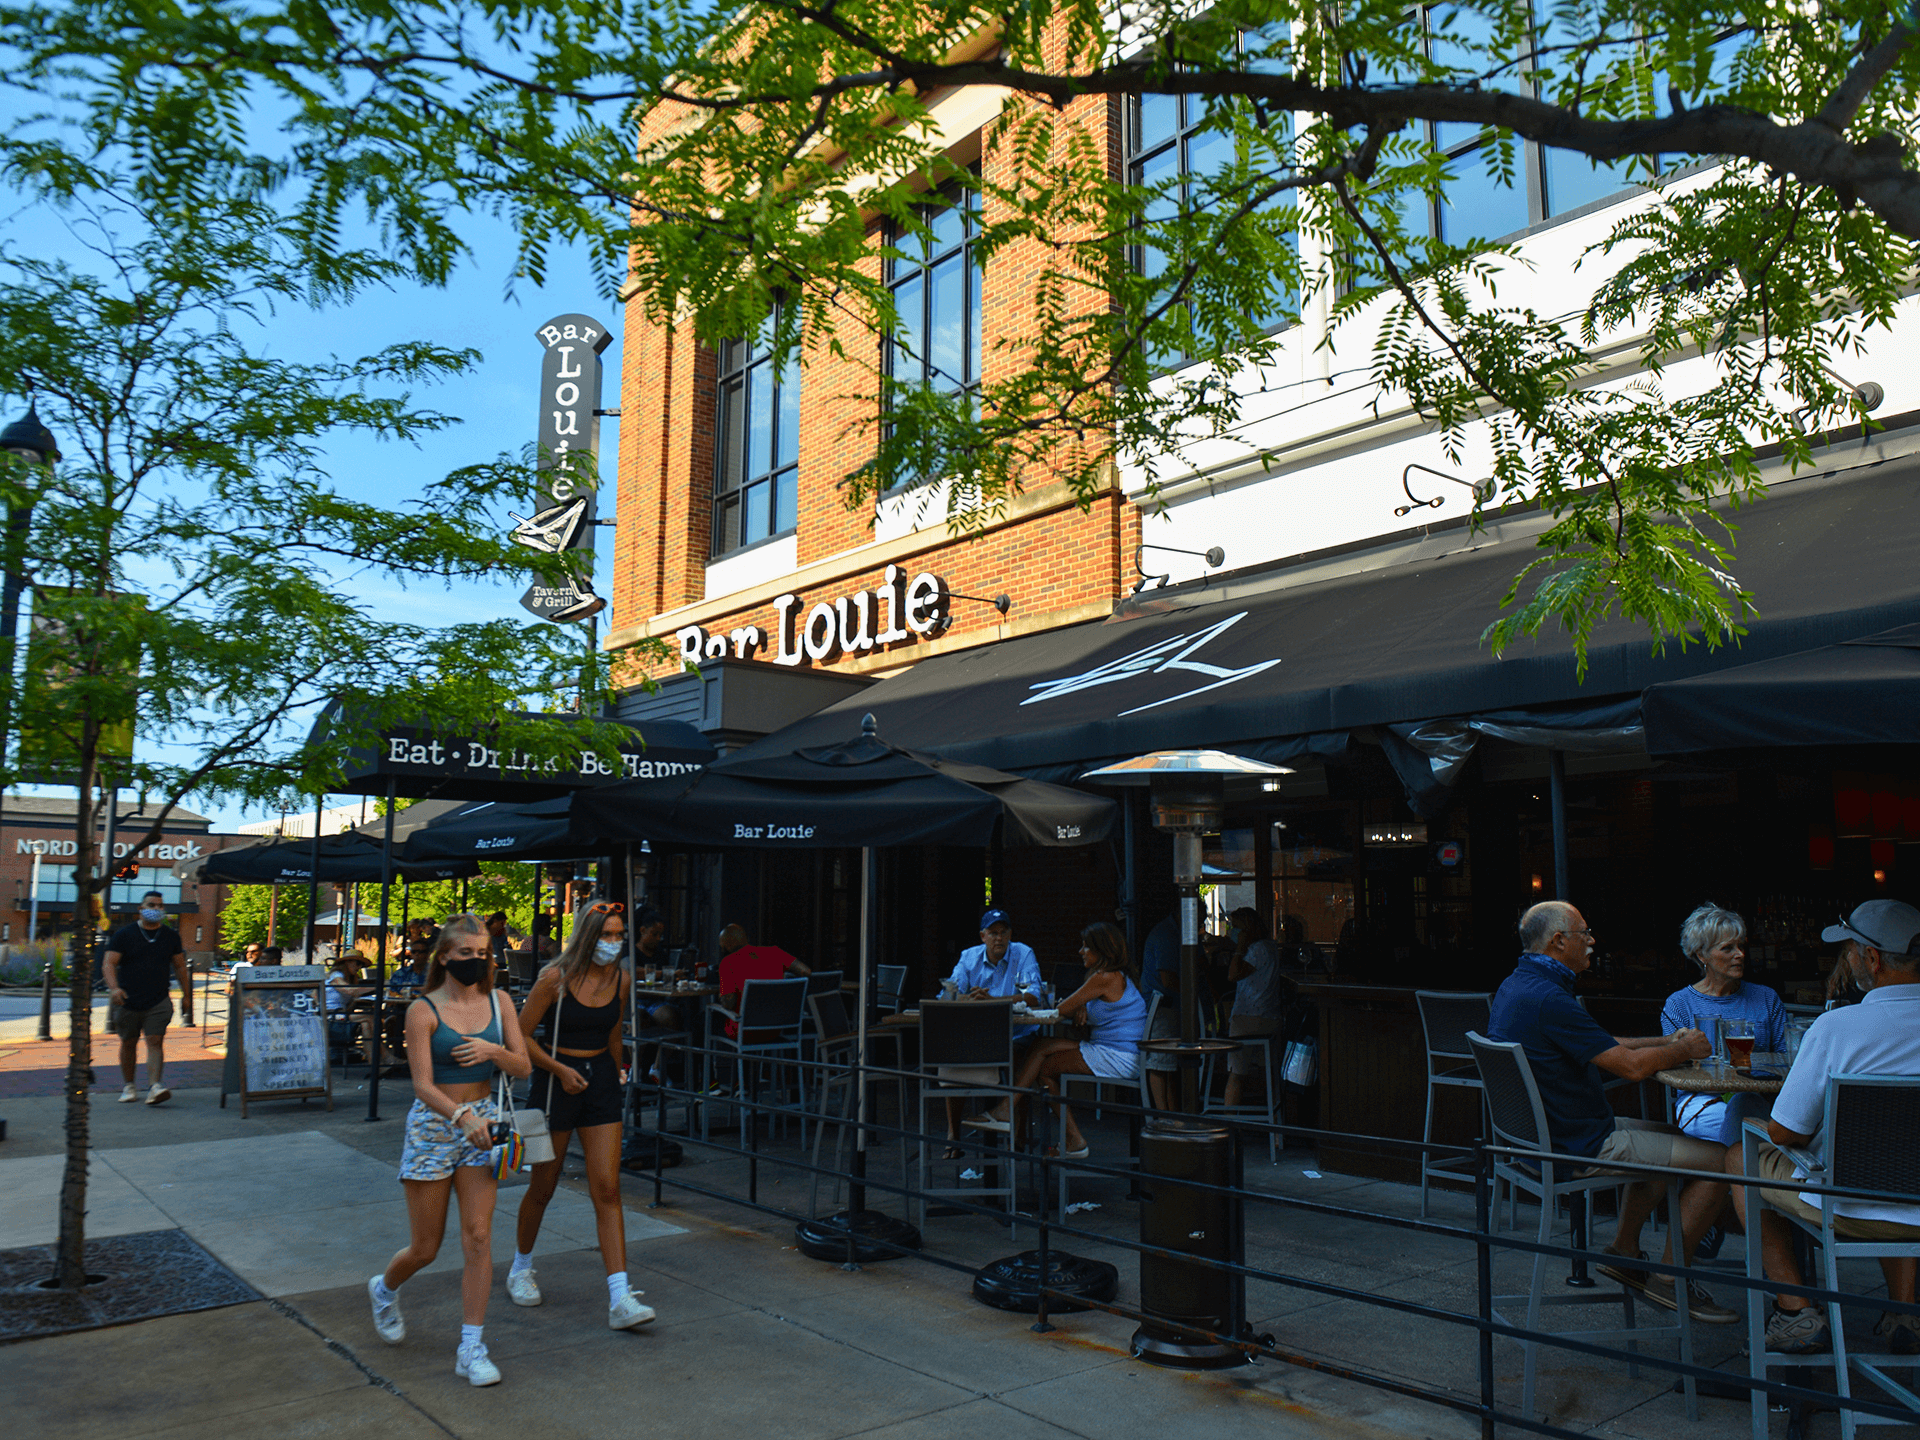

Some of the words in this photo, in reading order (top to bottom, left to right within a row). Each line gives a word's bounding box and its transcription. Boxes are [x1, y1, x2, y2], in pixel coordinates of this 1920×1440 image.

[539, 324, 597, 347] Bar
[552, 346, 581, 501] Louie
[532, 596, 544, 608] &
[545, 596, 574, 608] Grill
[676, 625, 760, 673] Bar
[773, 563, 943, 667] Louie
[388, 737, 446, 766] Eat
[579, 751, 613, 775] Be
[733, 823, 764, 839] Bar
[766, 823, 815, 839] Louie
[148, 840, 202, 861] rack
[475, 839, 492, 849] Bar
[491, 836, 516, 848] Louie
[254, 970, 276, 979] Bar
[278, 969, 311, 979] Louie
